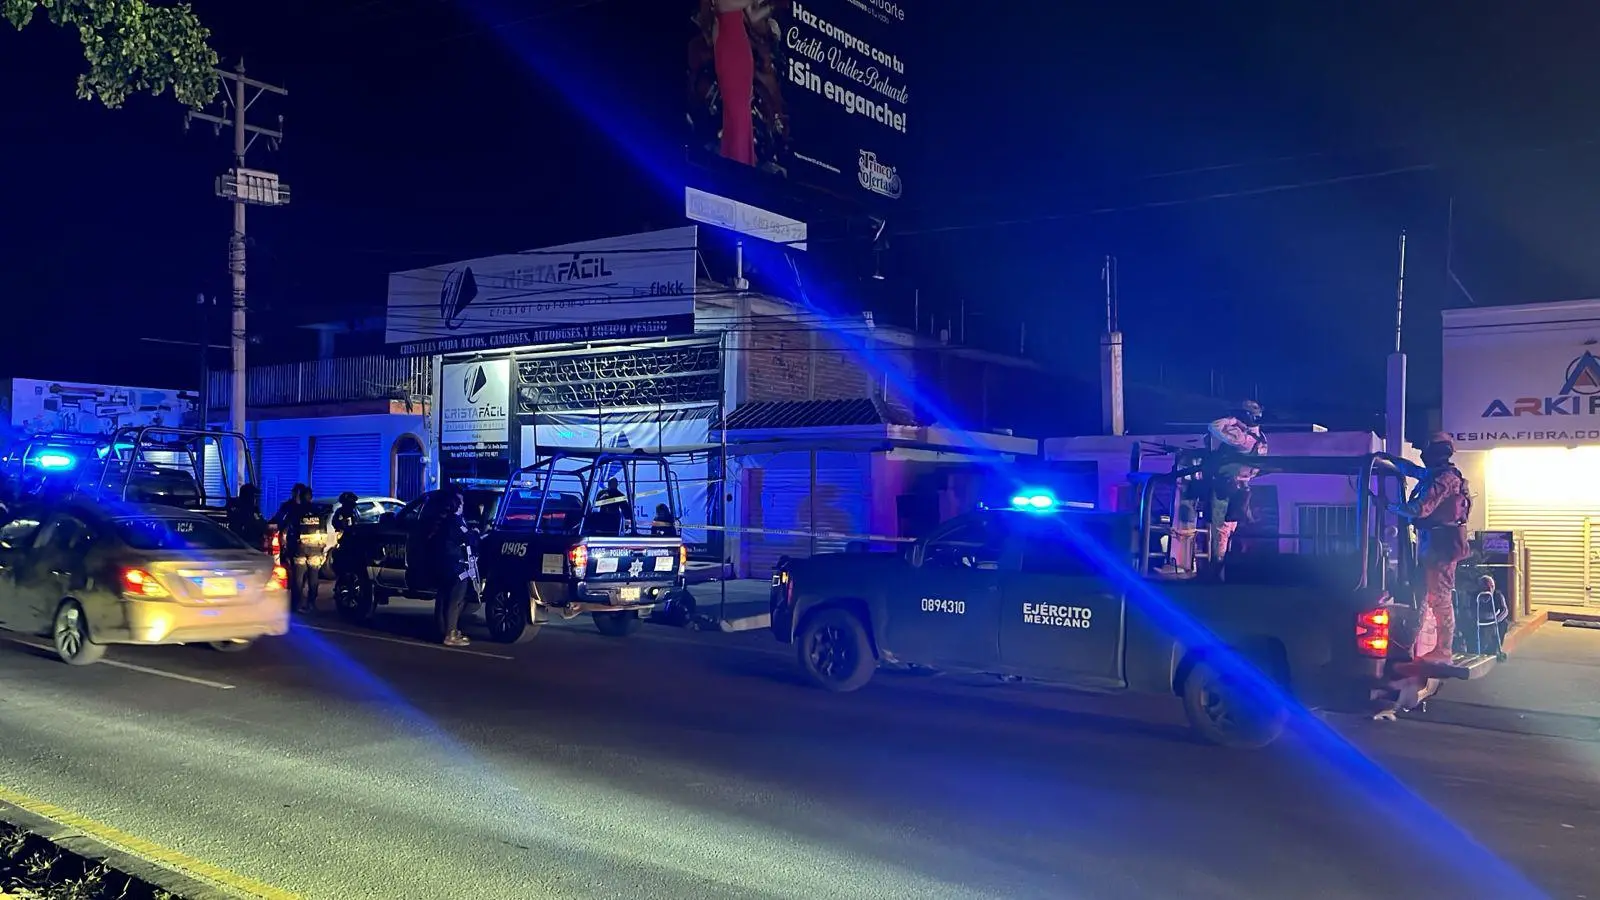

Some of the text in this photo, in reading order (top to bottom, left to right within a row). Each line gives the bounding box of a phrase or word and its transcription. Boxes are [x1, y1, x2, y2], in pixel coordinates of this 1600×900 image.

[792, 1, 818, 29] Haz
[819, 19, 870, 56] compras
[871, 47, 892, 68] con
[892, 55, 904, 74] tu
[786, 26, 909, 104] Crédito Valdez Baluarte
[788, 57, 906, 134] ¡Sin enganche!
[438, 339, 459, 351] PARA
[460, 337, 488, 349] AUTOS,
[489, 332, 531, 347] CAMIONES,
[501, 542, 528, 557] 0905
[921, 598, 966, 614] 0894310
[1023, 602, 1092, 620] EJÉRCITO
[1024, 615, 1090, 629] MEXICANO
